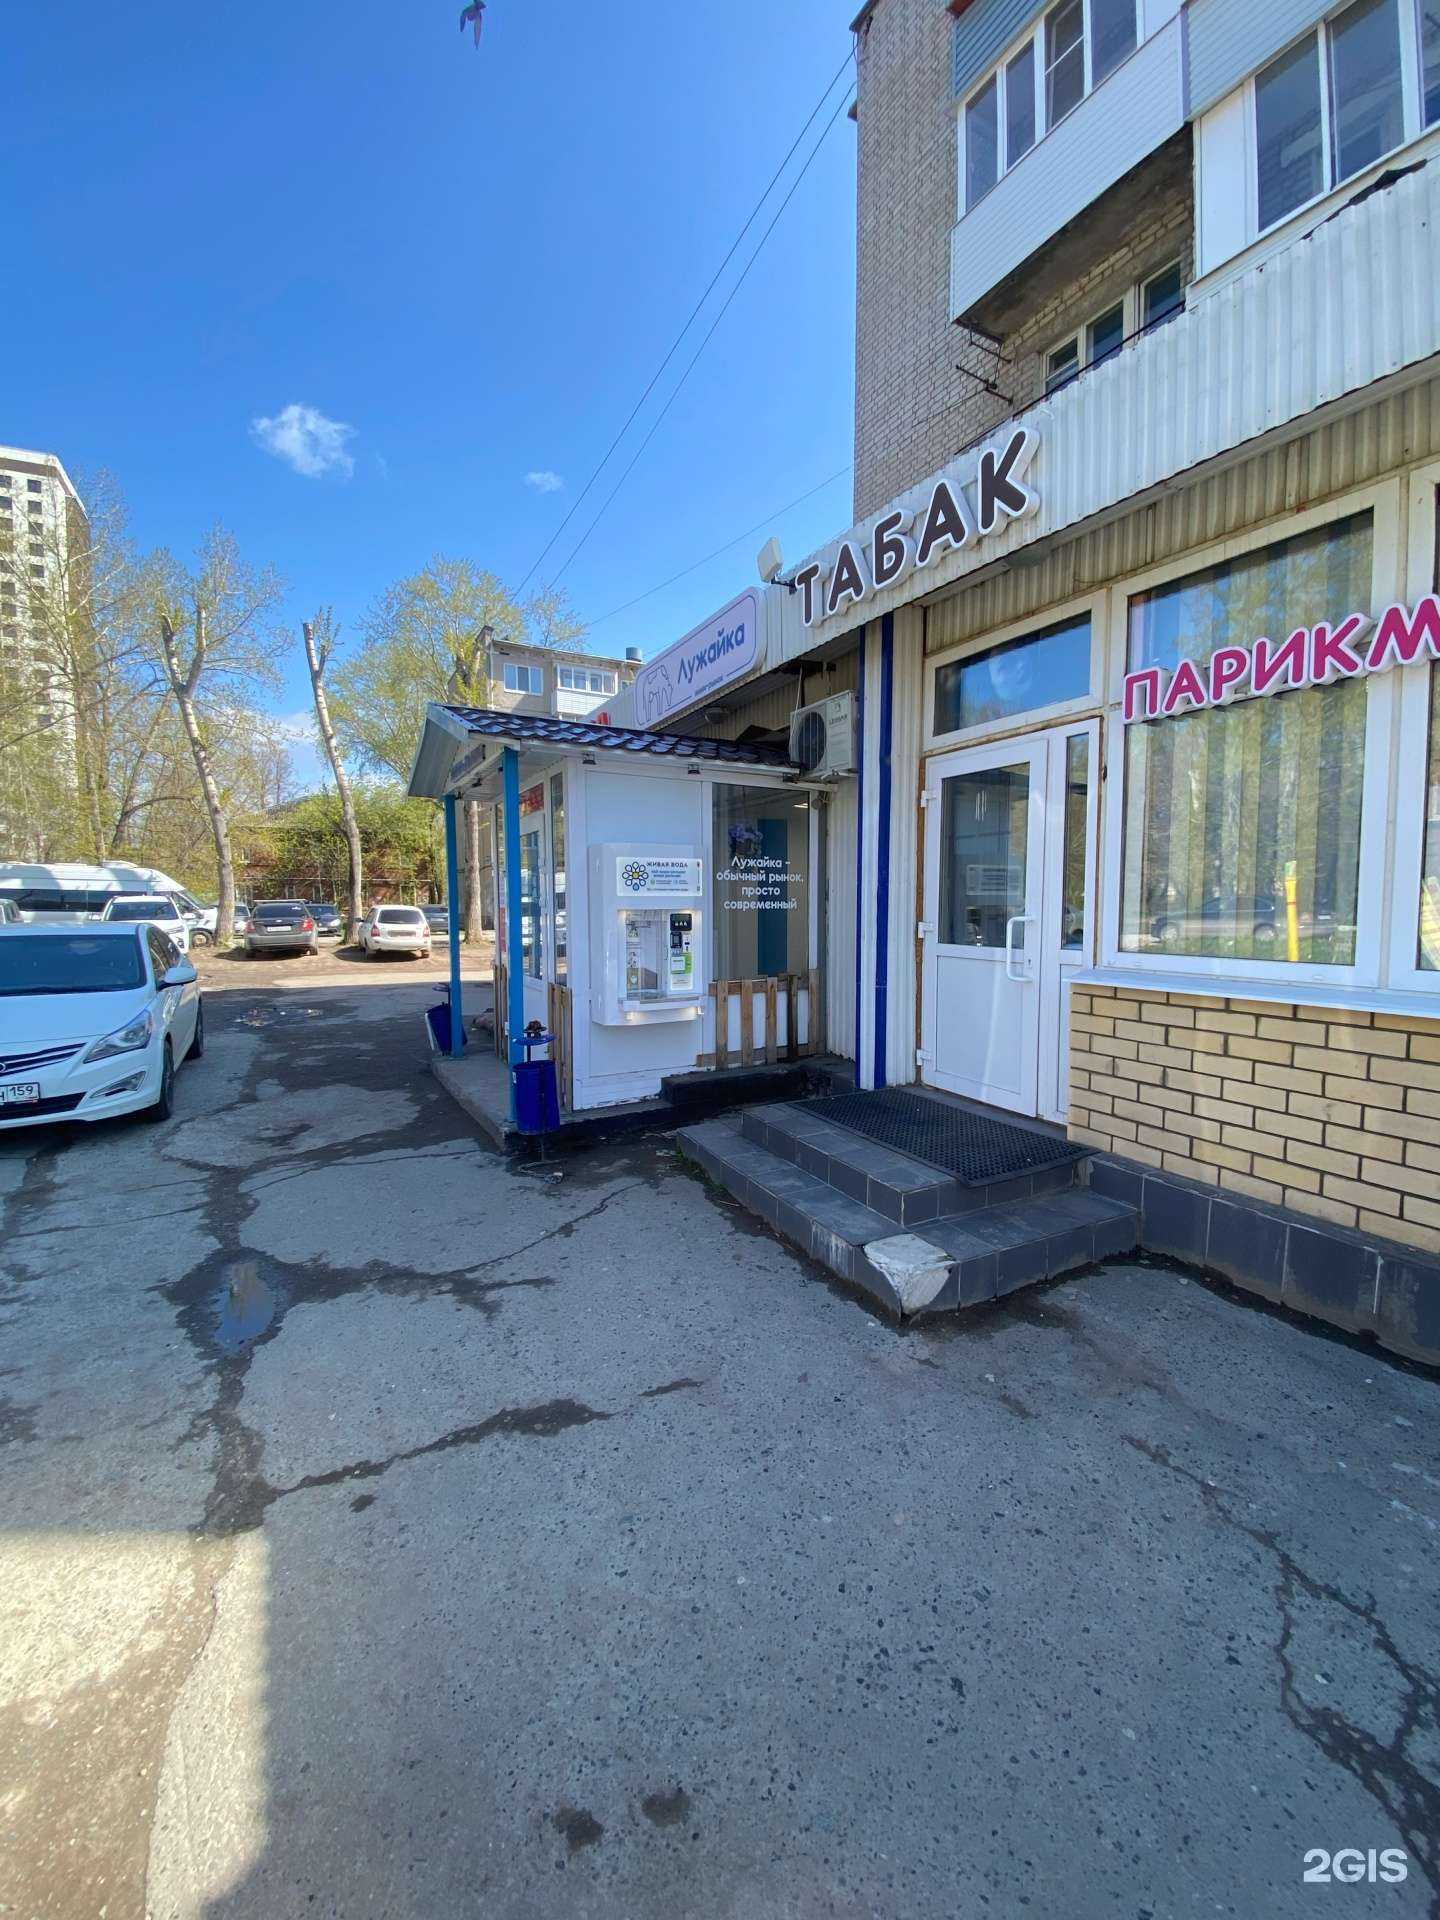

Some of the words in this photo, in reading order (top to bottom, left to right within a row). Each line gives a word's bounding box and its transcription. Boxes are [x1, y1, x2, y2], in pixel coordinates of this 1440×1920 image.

[796, 427, 1036, 626] ТАБАК
[677, 622, 745, 685] Лужайка
[1123, 593, 1440, 723] ПАРИКМ
[731, 855, 782, 869] Лужайка
[716, 869, 766, 881] обычный
[741, 886, 780, 897] просто
[723, 898, 797, 911] современный
[9, 1085, 33, 1097] 159
